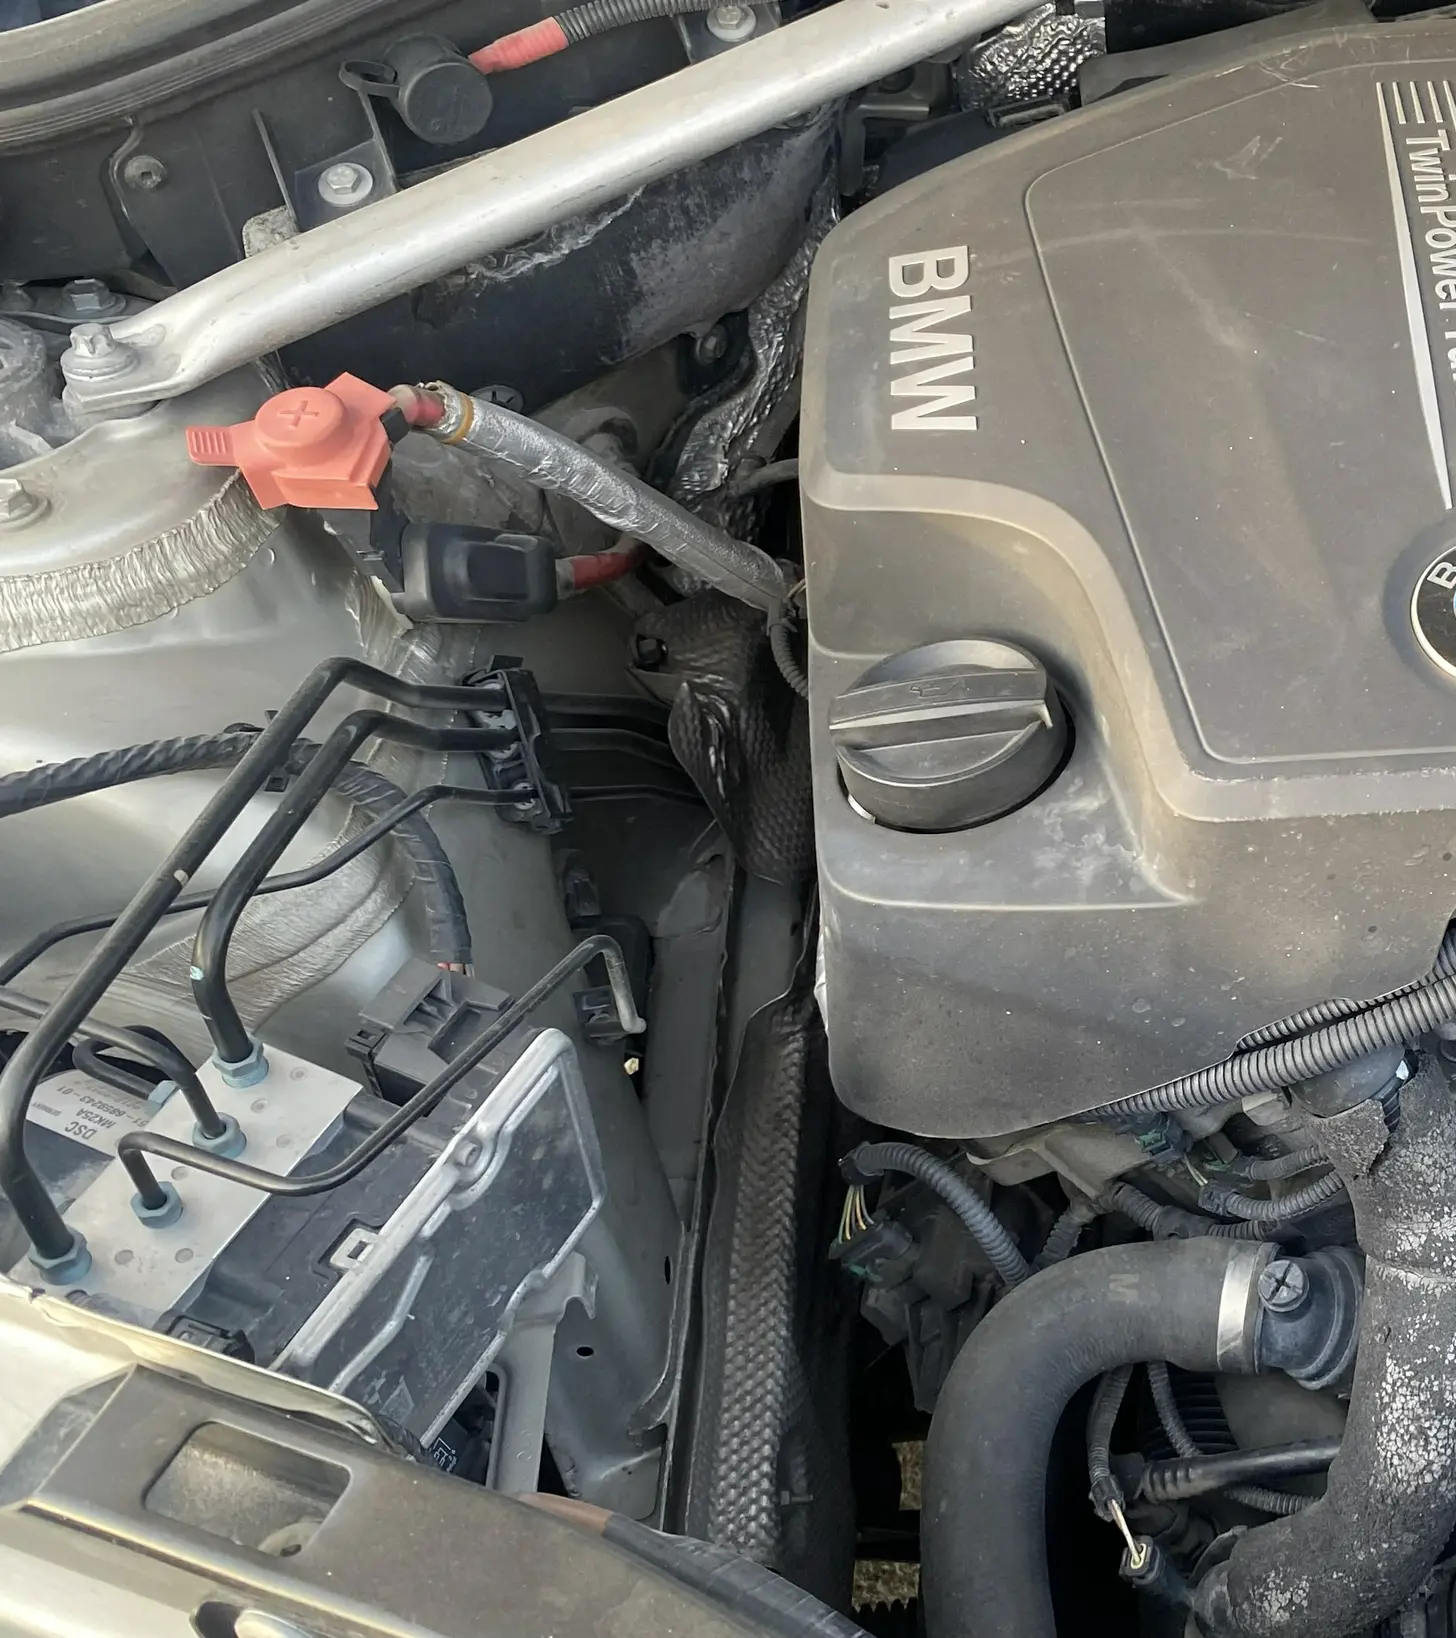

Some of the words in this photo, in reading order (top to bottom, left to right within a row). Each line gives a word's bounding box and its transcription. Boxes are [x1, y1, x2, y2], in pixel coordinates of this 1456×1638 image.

[888, 244, 978, 432] BMW
[76, 1107, 117, 1129] MK25A
[64, 1120, 98, 1140] DSC
